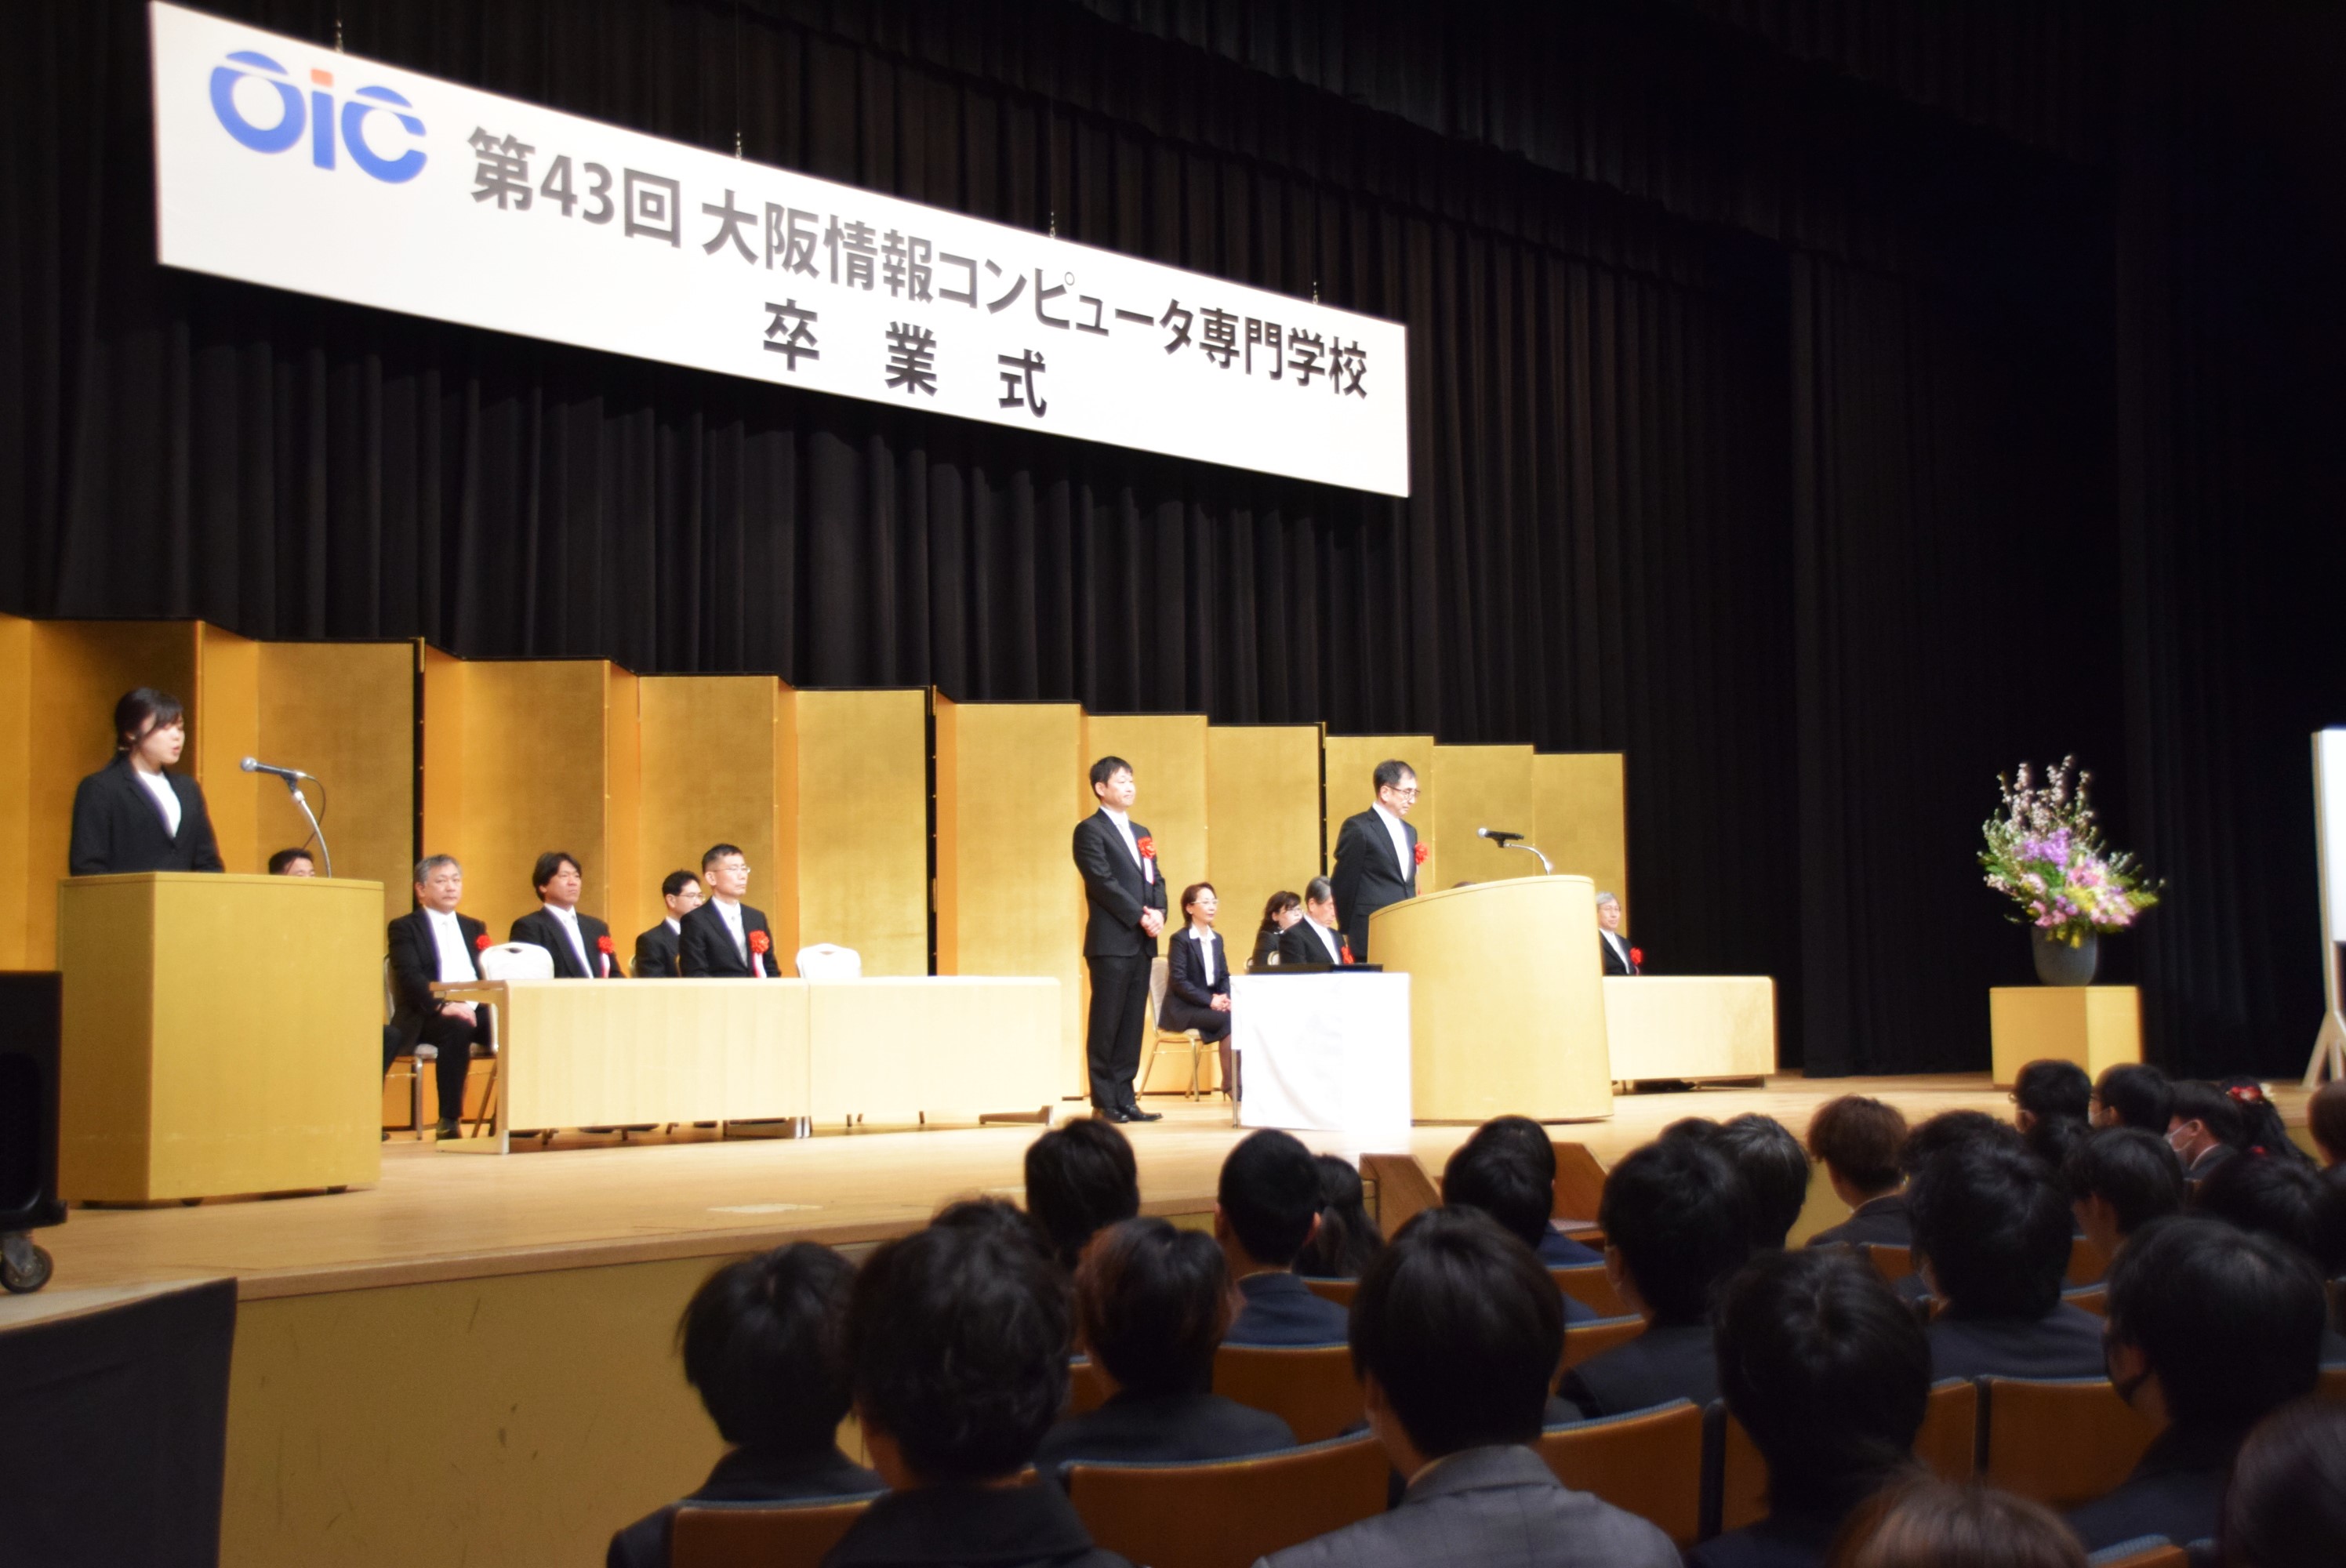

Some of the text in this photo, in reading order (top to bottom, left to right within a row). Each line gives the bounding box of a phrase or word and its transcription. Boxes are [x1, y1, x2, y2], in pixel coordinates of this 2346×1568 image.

[467, 126, 1368, 401] 第43回 大阪情報コンピュータ専門学校
